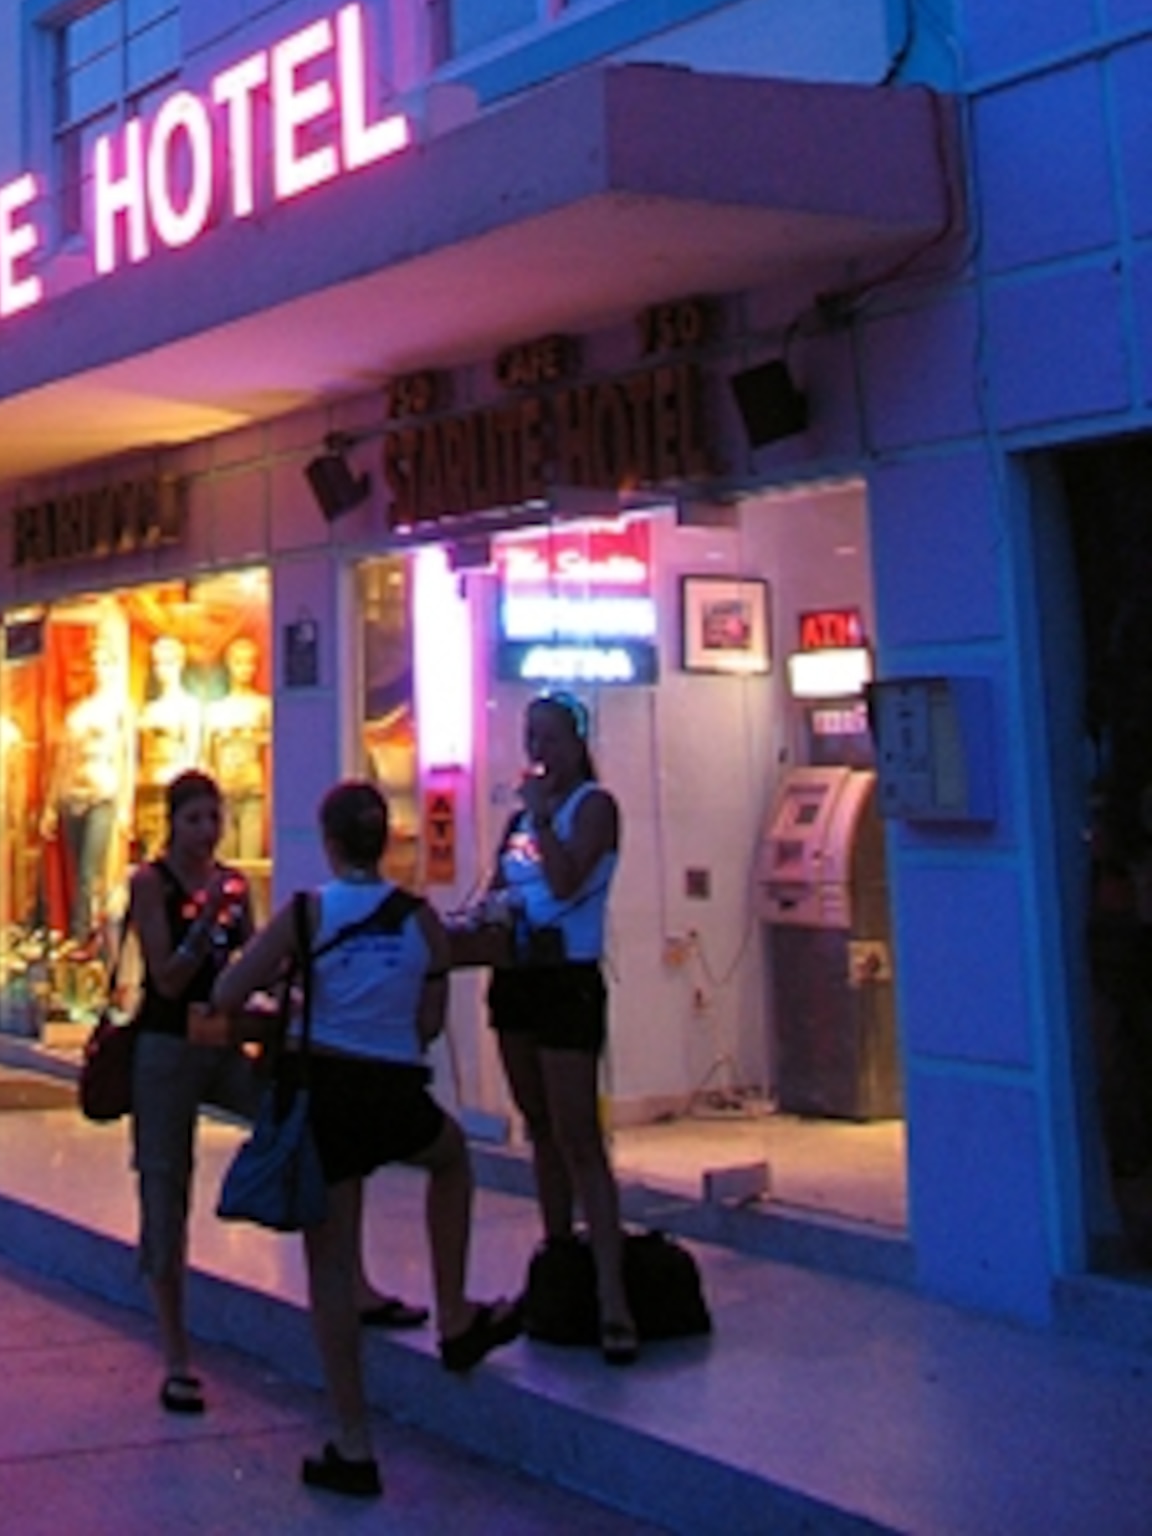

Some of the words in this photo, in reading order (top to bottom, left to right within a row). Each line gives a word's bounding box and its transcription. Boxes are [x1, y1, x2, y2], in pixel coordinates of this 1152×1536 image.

[94, 3, 410, 274] HOTEL
[385, 396, 546, 524] STARLITE
[554, 360, 714, 489] HOTEL
[428, 793, 456, 861] ATM
